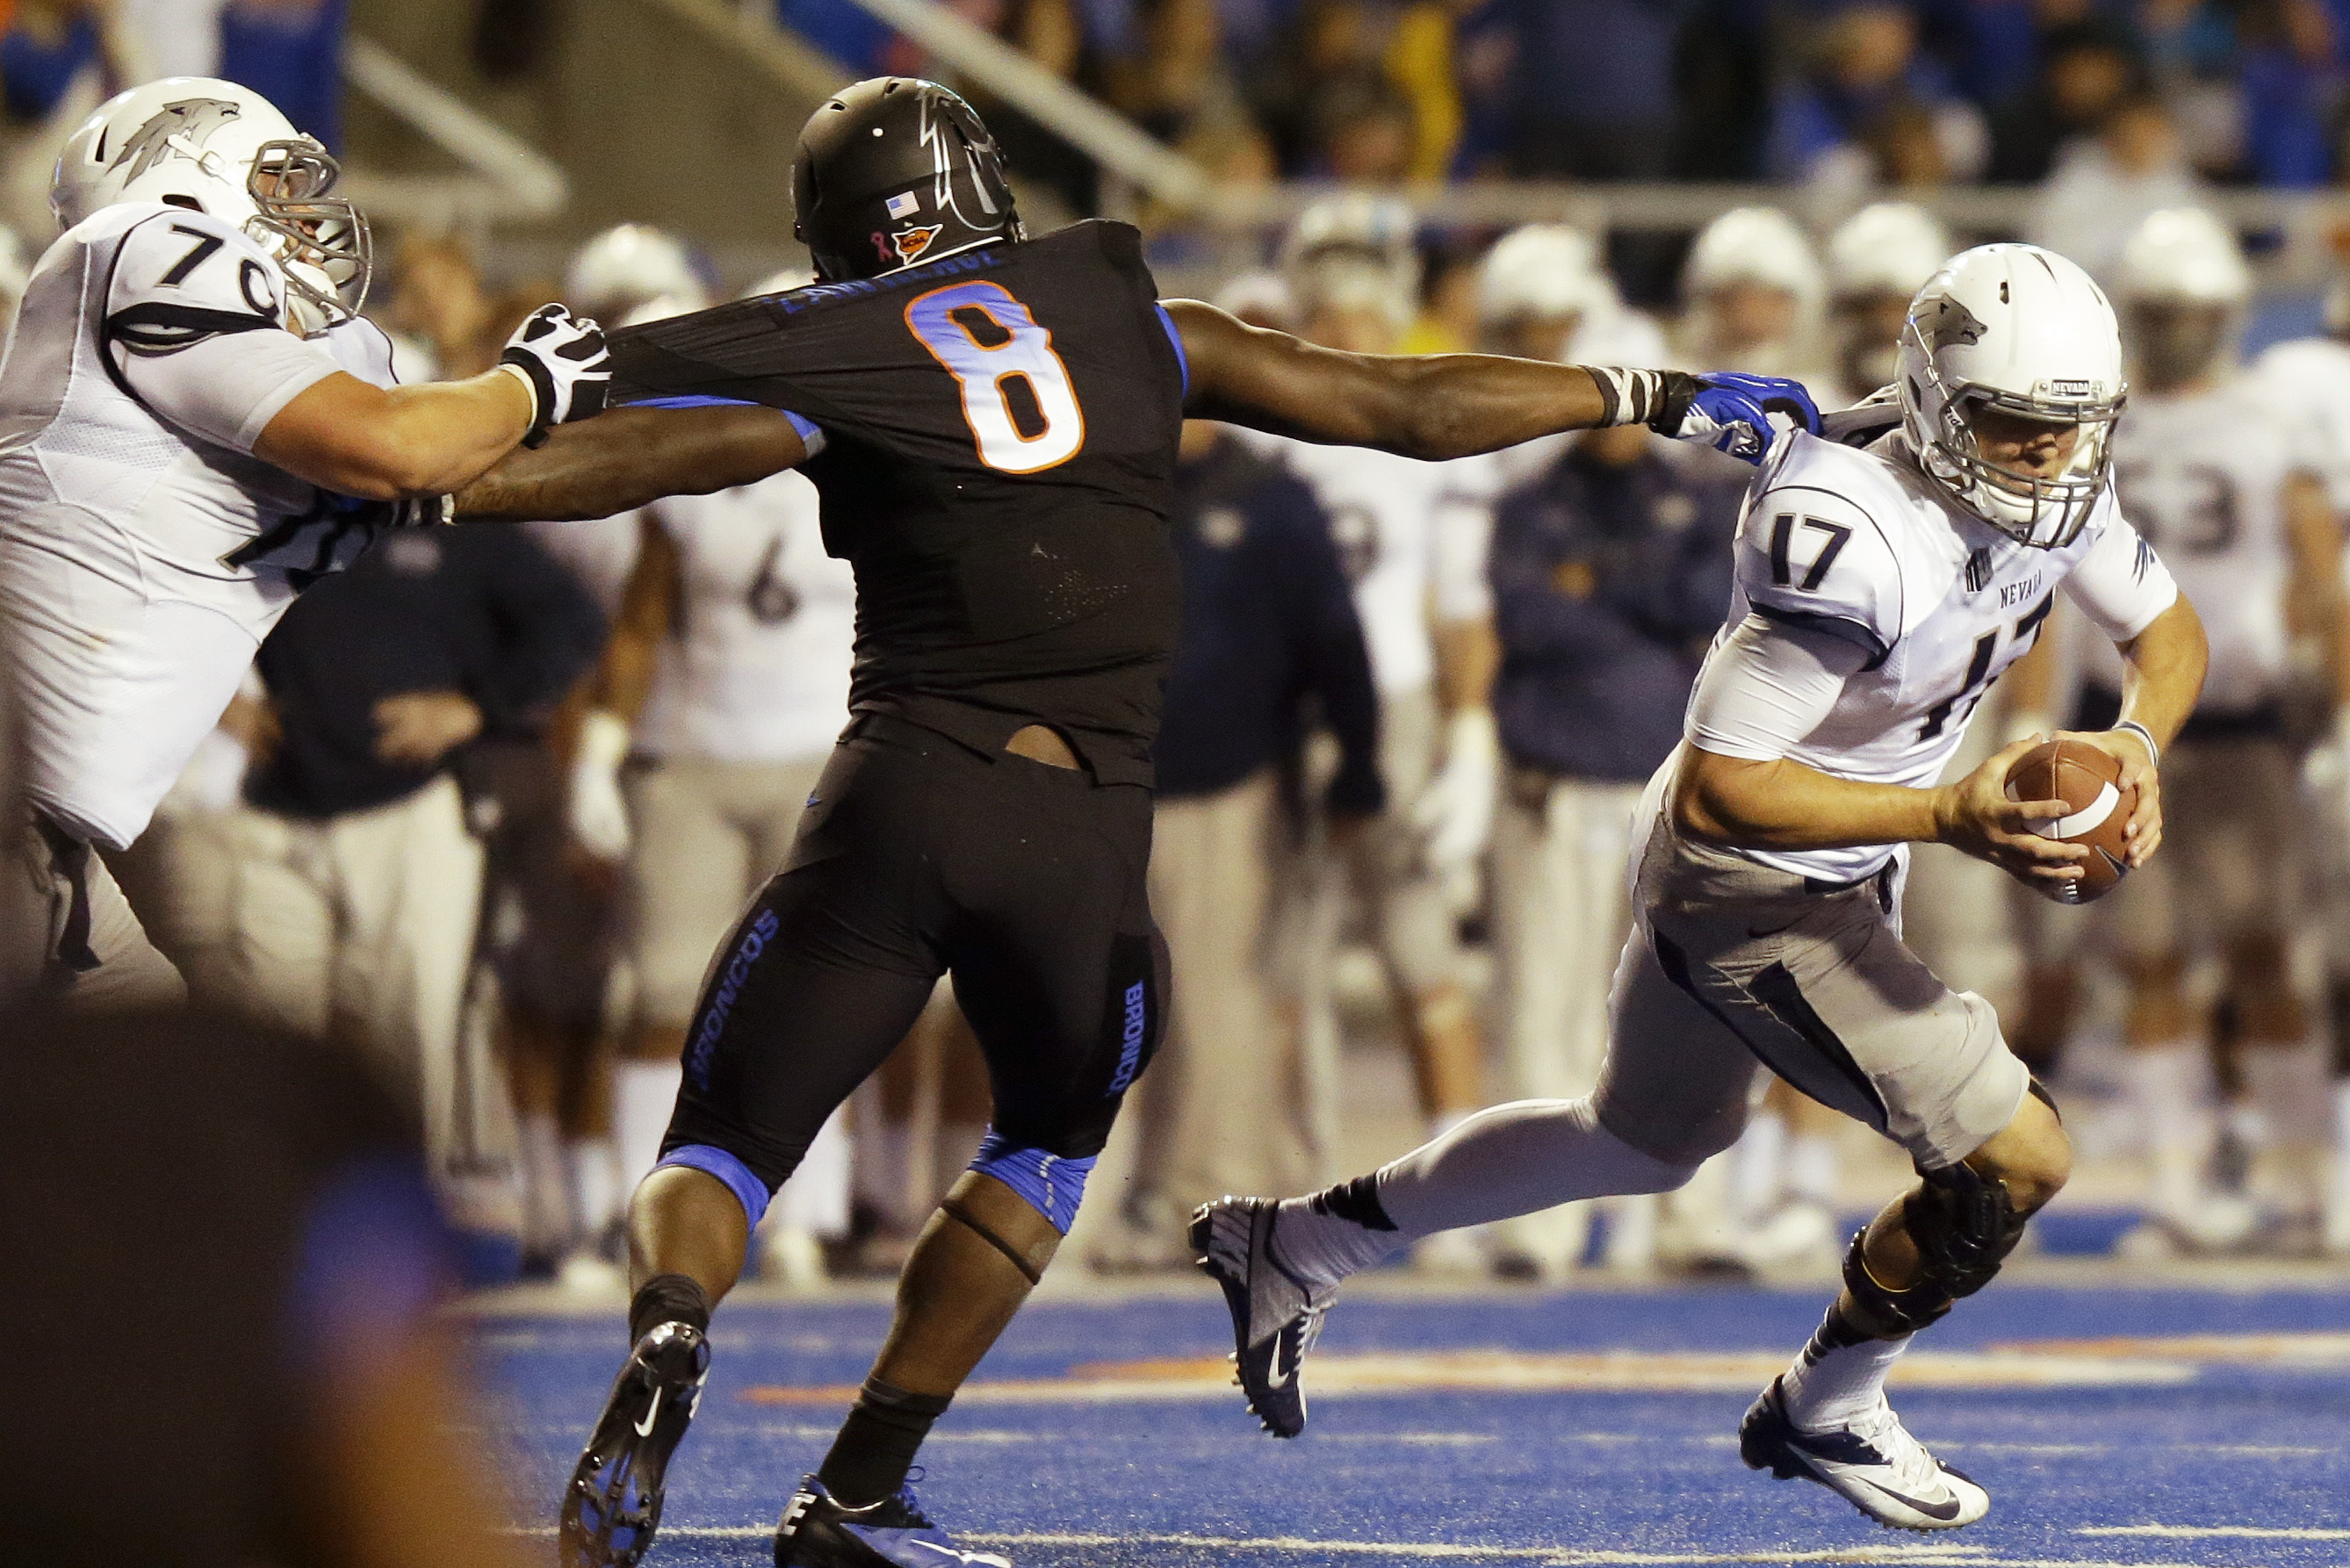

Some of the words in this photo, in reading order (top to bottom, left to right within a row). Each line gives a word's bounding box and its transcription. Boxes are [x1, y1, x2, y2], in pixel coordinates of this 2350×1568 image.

[904, 279, 1085, 475] 8
[746, 533, 802, 628] 6
[1770, 513, 1854, 593] 17
